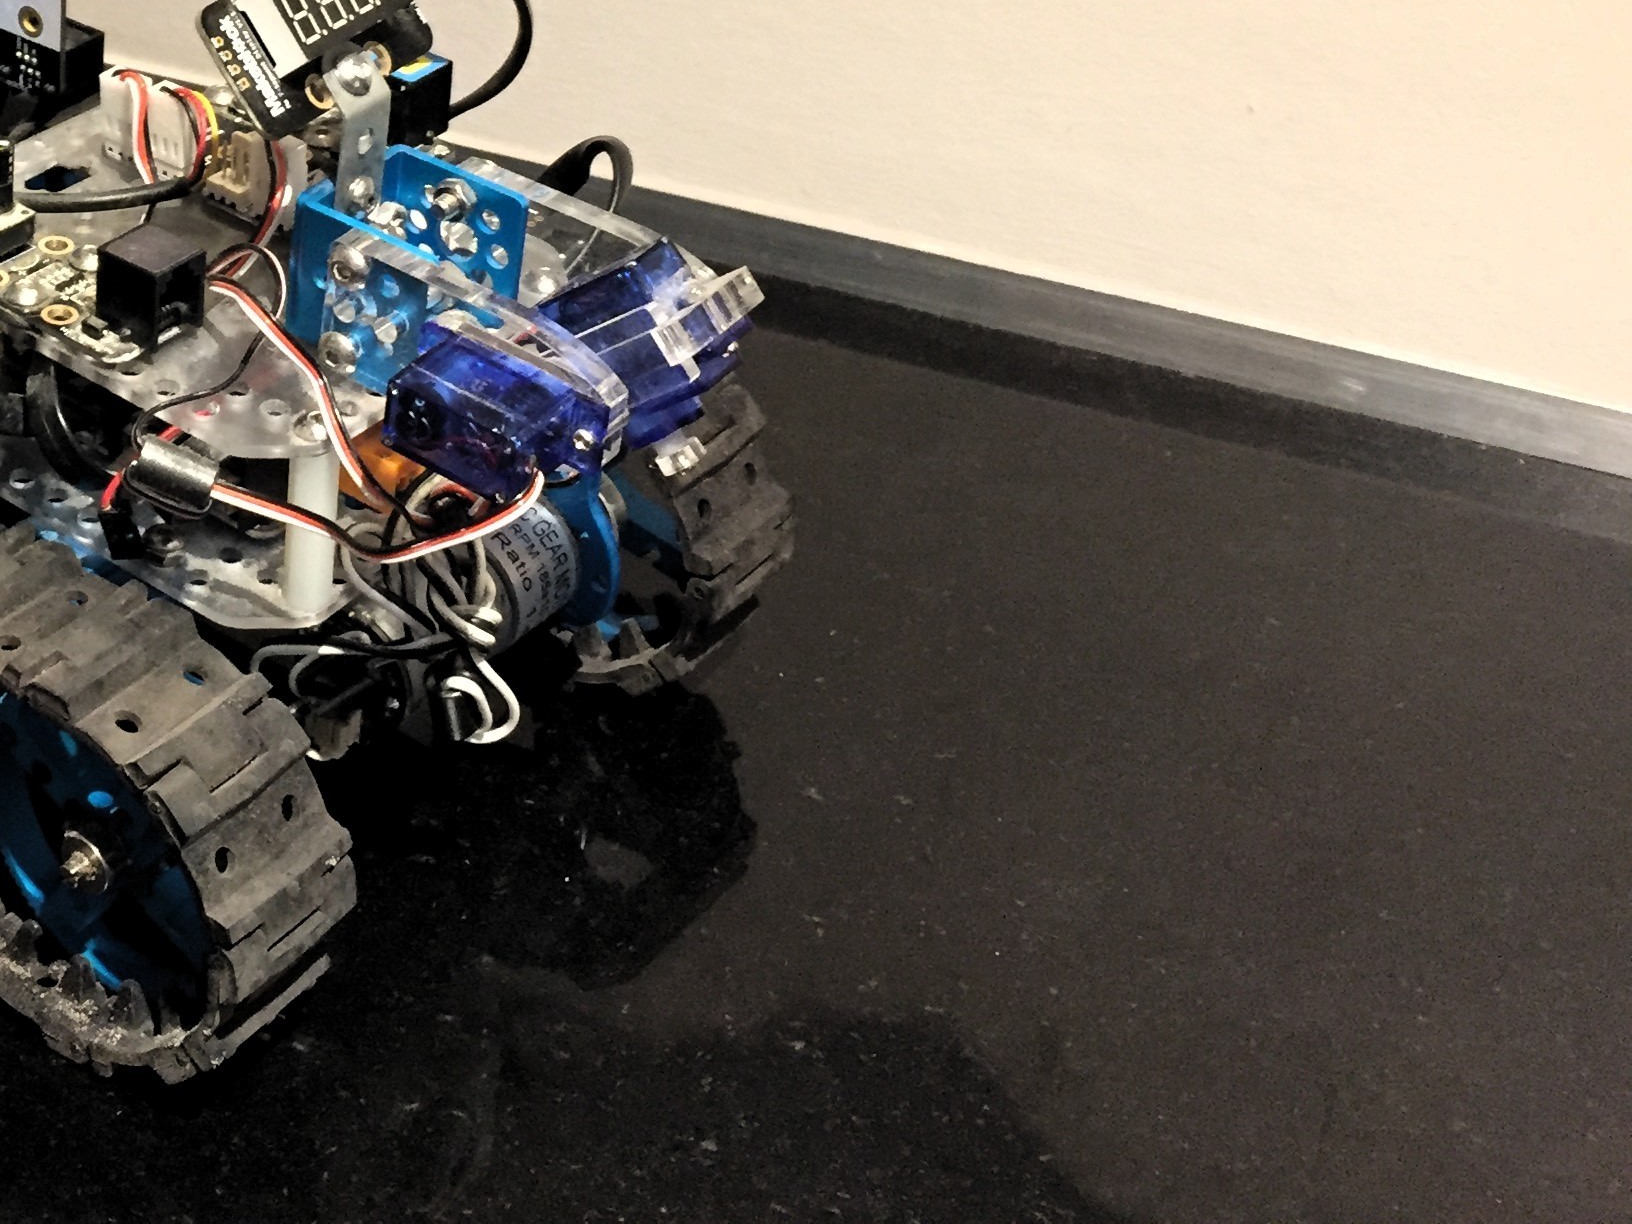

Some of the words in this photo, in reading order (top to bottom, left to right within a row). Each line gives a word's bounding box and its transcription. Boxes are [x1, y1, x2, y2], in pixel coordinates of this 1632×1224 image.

[218, 14, 286, 118] Makeblock
[490, 531, 533, 592] Ratio
[509, 523, 541, 561] RPM
[532, 519, 568, 571] GEAR
